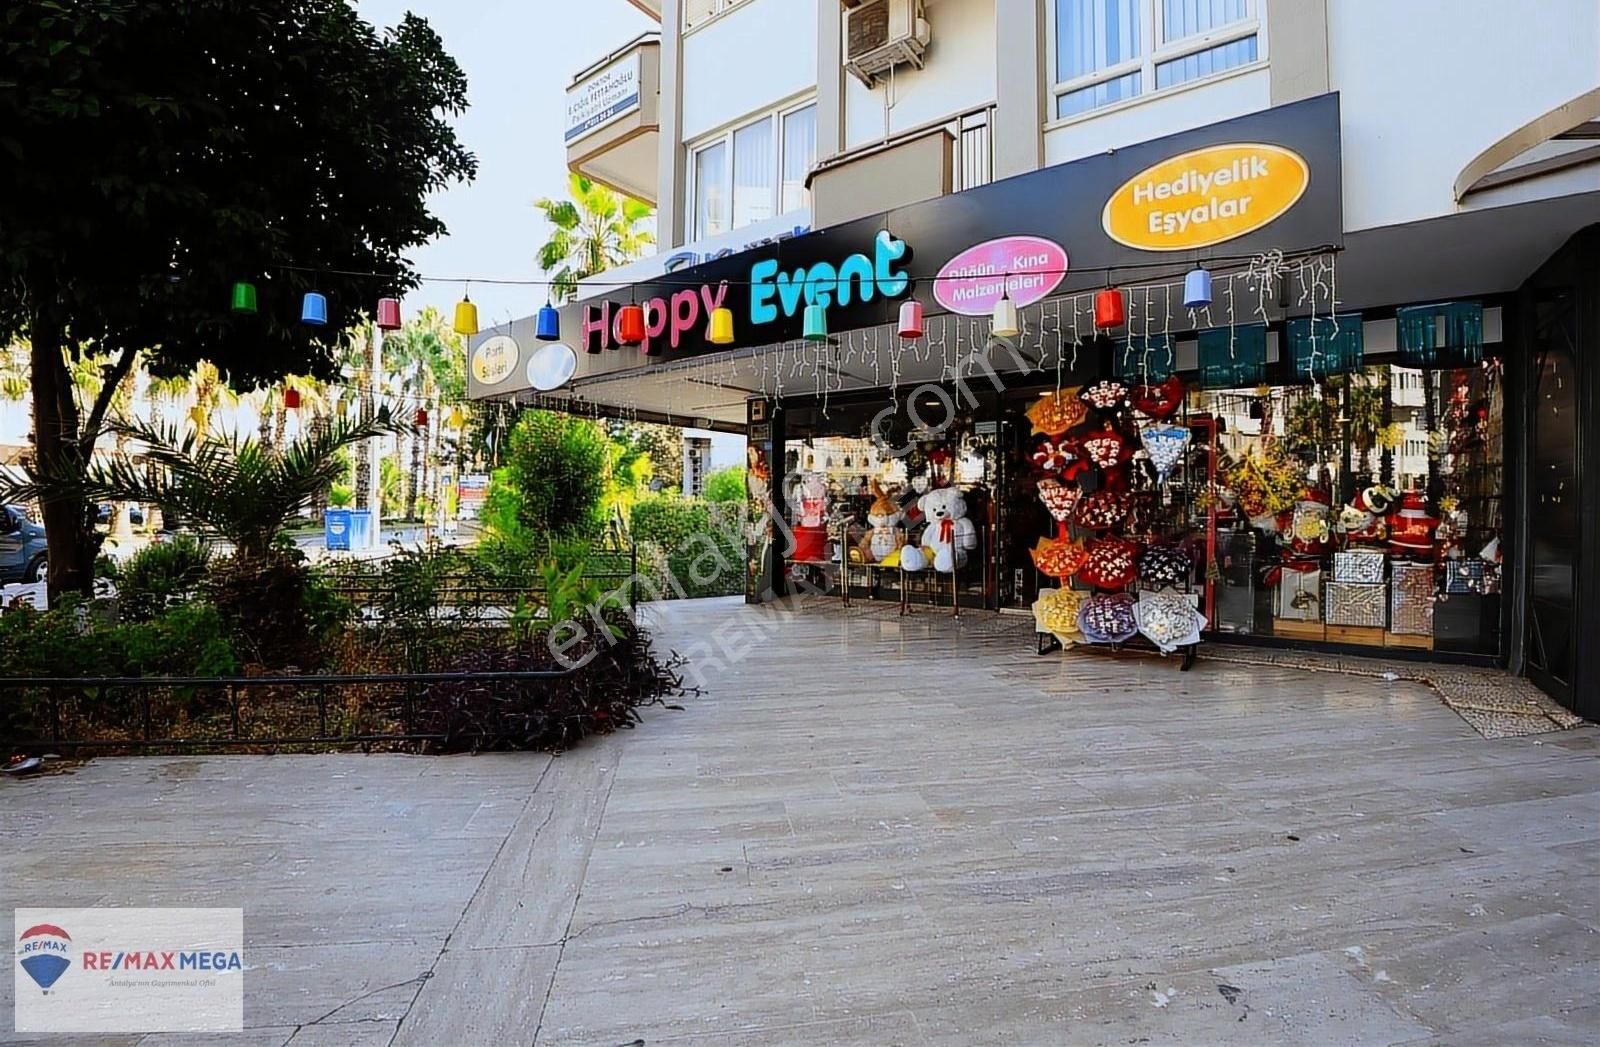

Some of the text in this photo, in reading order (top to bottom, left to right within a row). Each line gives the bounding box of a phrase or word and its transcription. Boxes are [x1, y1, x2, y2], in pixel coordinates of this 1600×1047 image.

[1133, 155, 1269, 205] Hediyelik
[1148, 196, 1253, 235] Eşyalar
[750, 229, 908, 325] Event
[1013, 253, 1049, 270] Kına
[952, 272, 1045, 303] Malzemeleri
